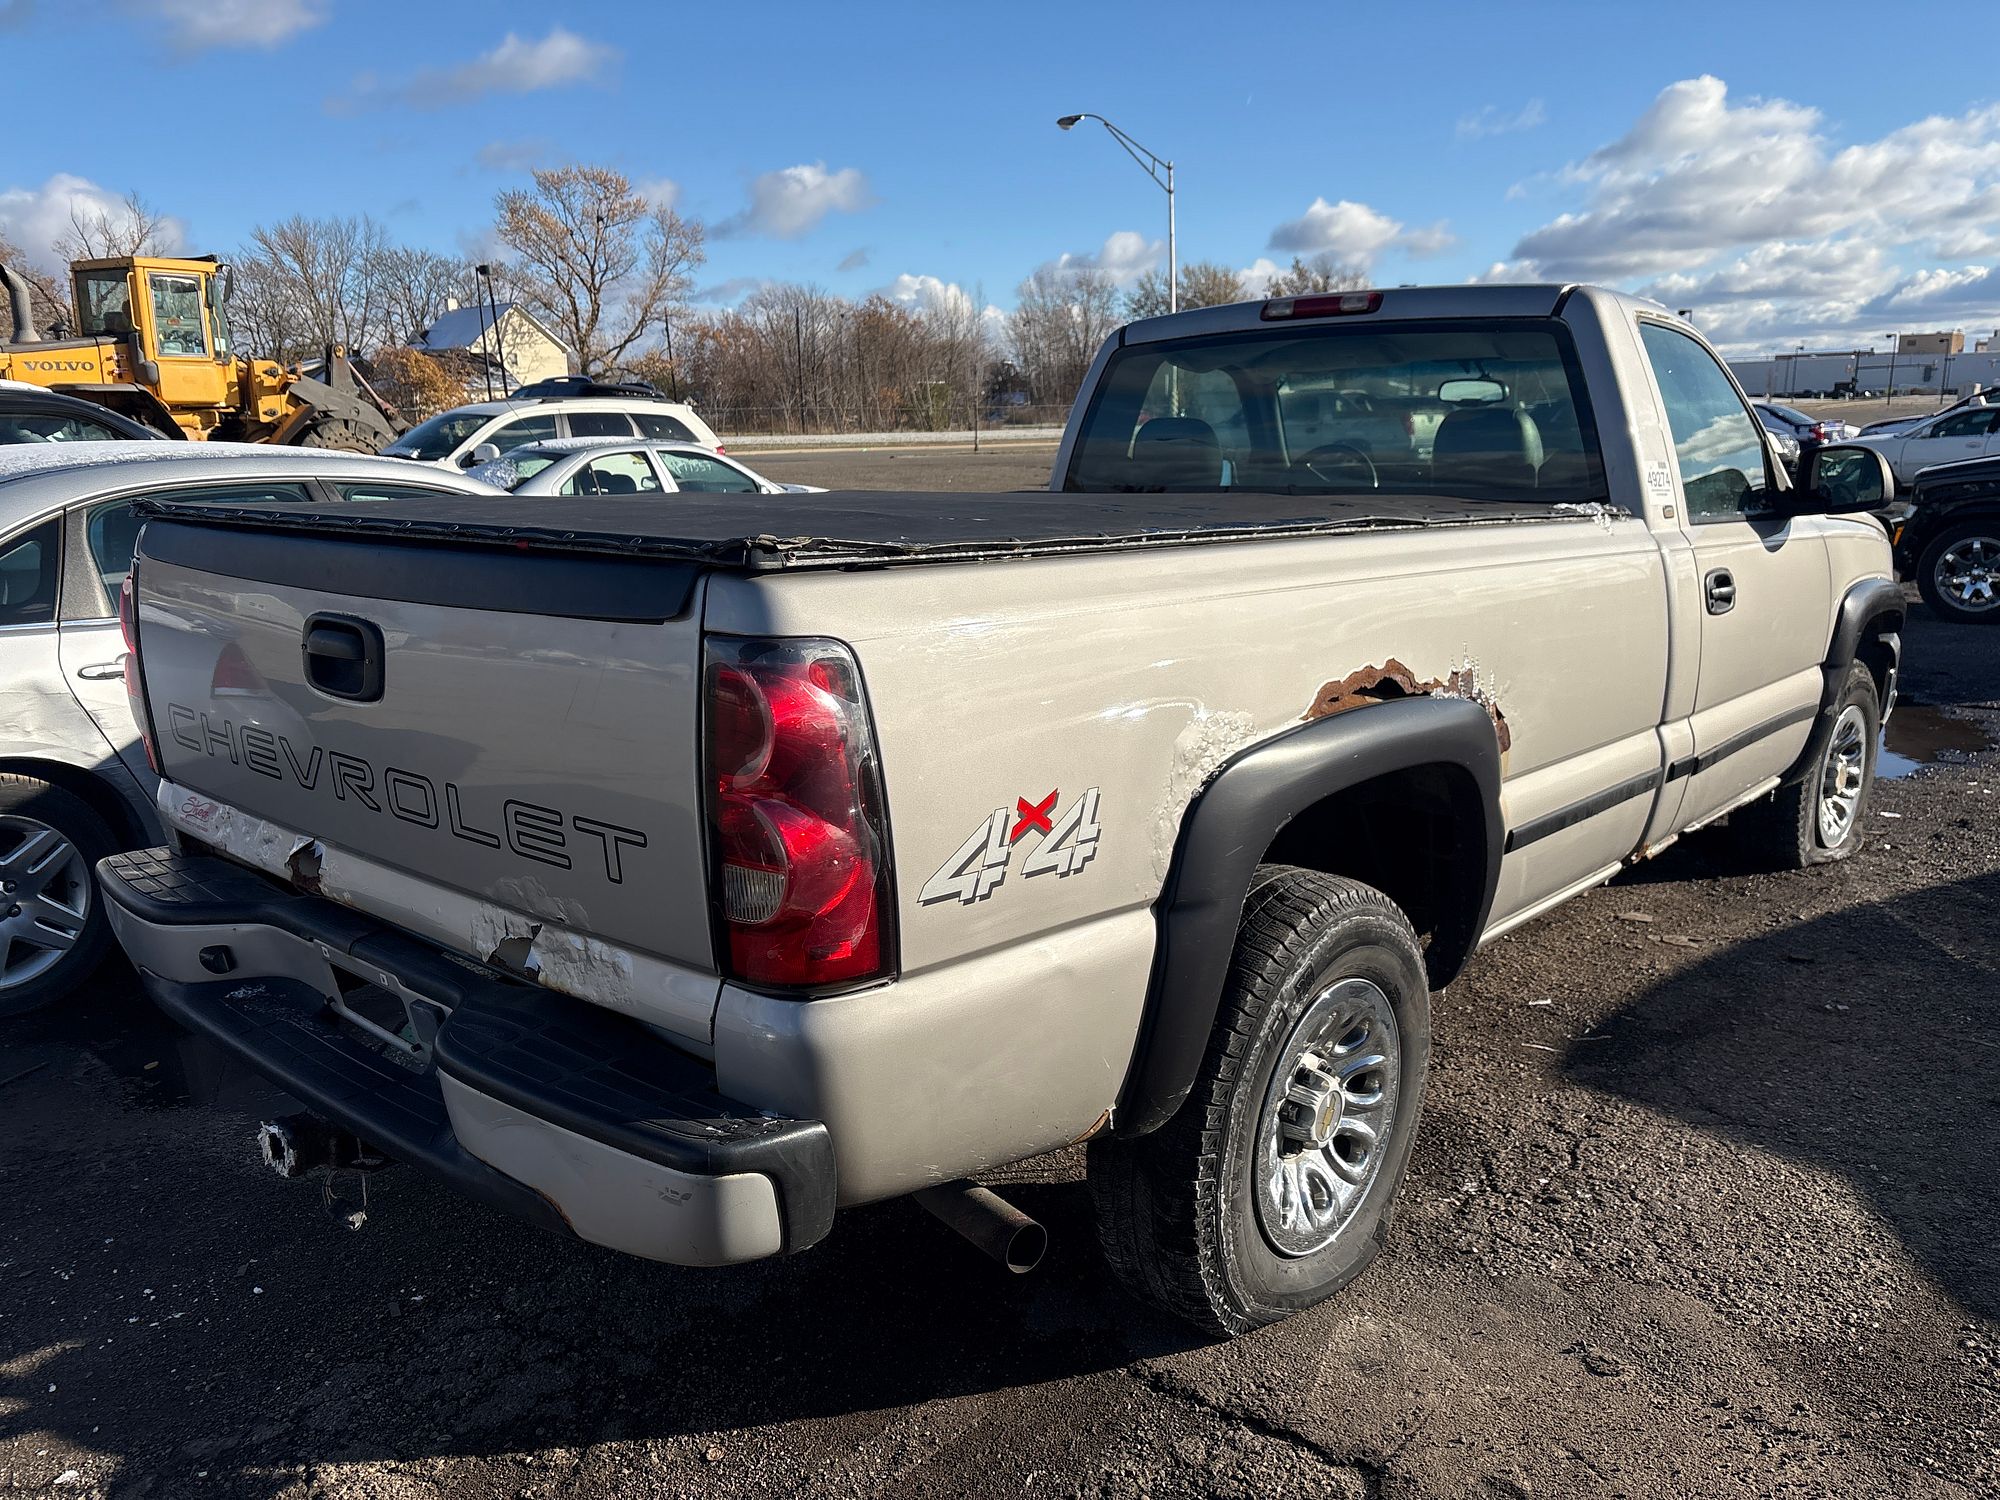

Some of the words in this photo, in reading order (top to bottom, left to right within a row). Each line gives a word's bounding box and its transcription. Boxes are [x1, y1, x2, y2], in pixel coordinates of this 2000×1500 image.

[22, 360, 94, 371] VOLVO
[1647, 471, 1671, 487] 49274
[167, 702, 648, 885] CHEVROLET
